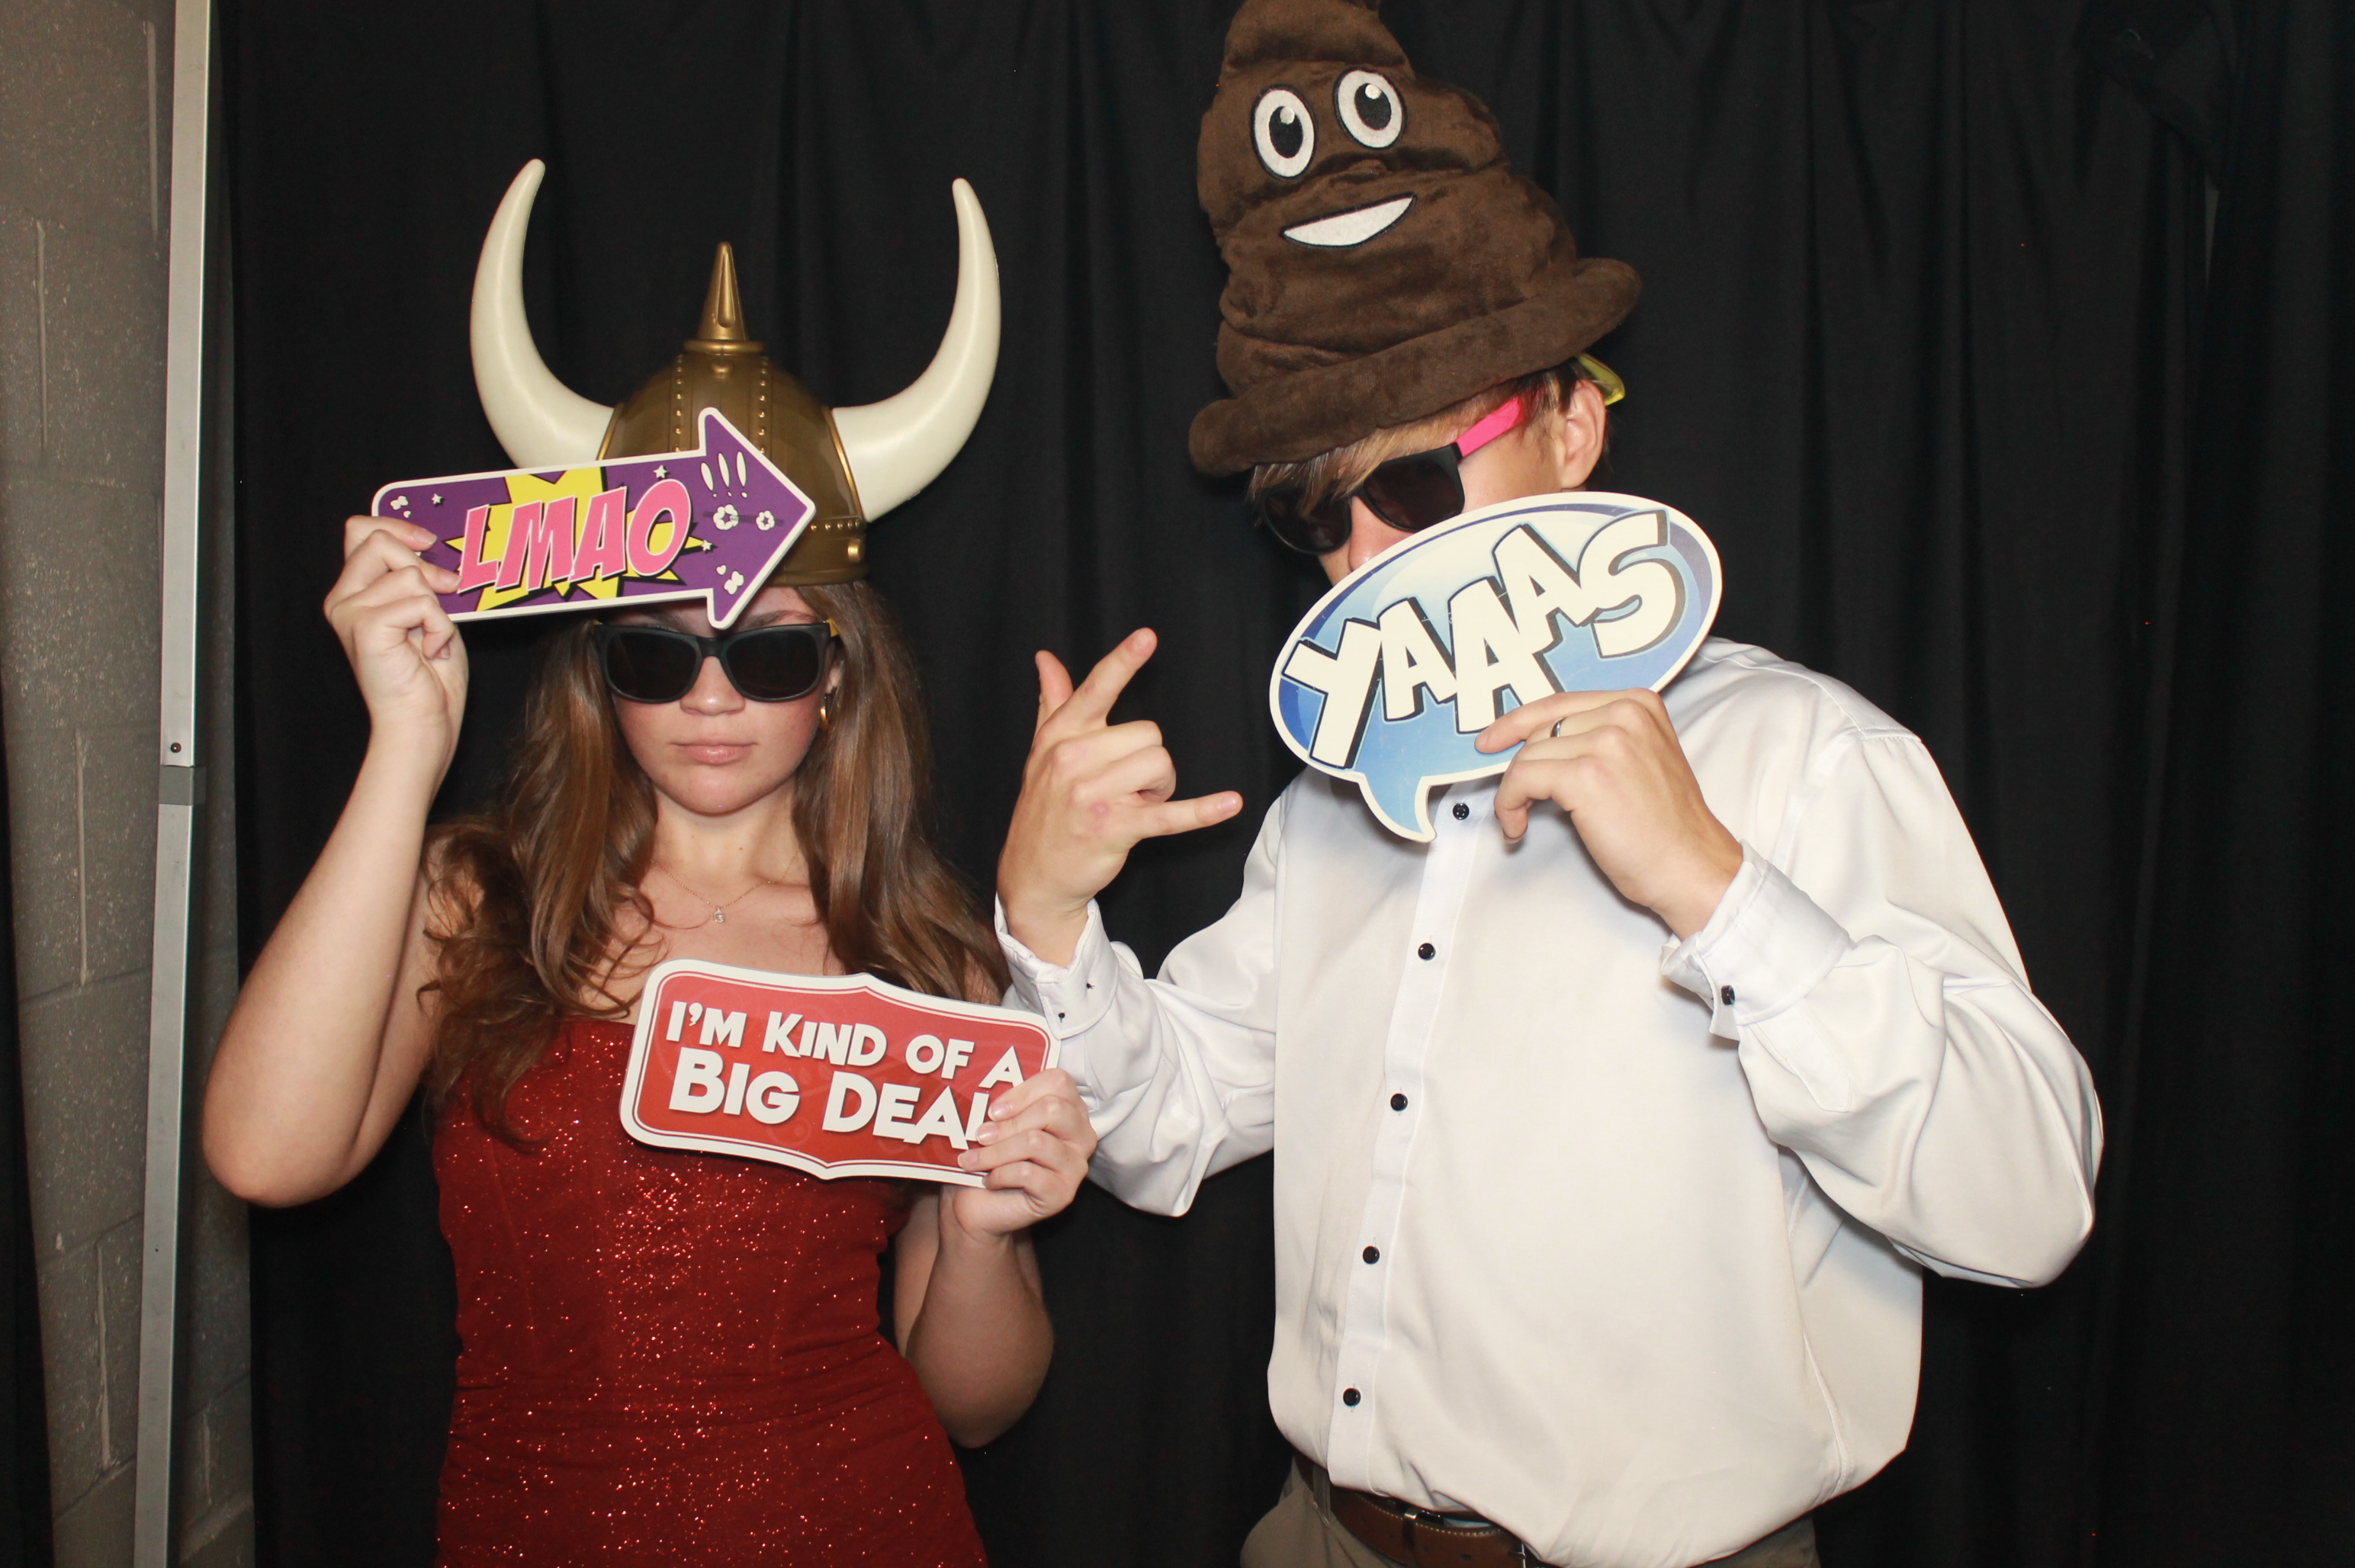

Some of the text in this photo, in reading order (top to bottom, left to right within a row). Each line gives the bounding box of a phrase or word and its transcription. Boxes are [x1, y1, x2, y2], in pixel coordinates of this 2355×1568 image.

[457, 478, 692, 594] LMAO
[1281, 509, 1686, 770] YAAAS
[666, 1001, 1025, 1088] I'M KIND OF A
[669, 1046, 801, 1124] BIG
